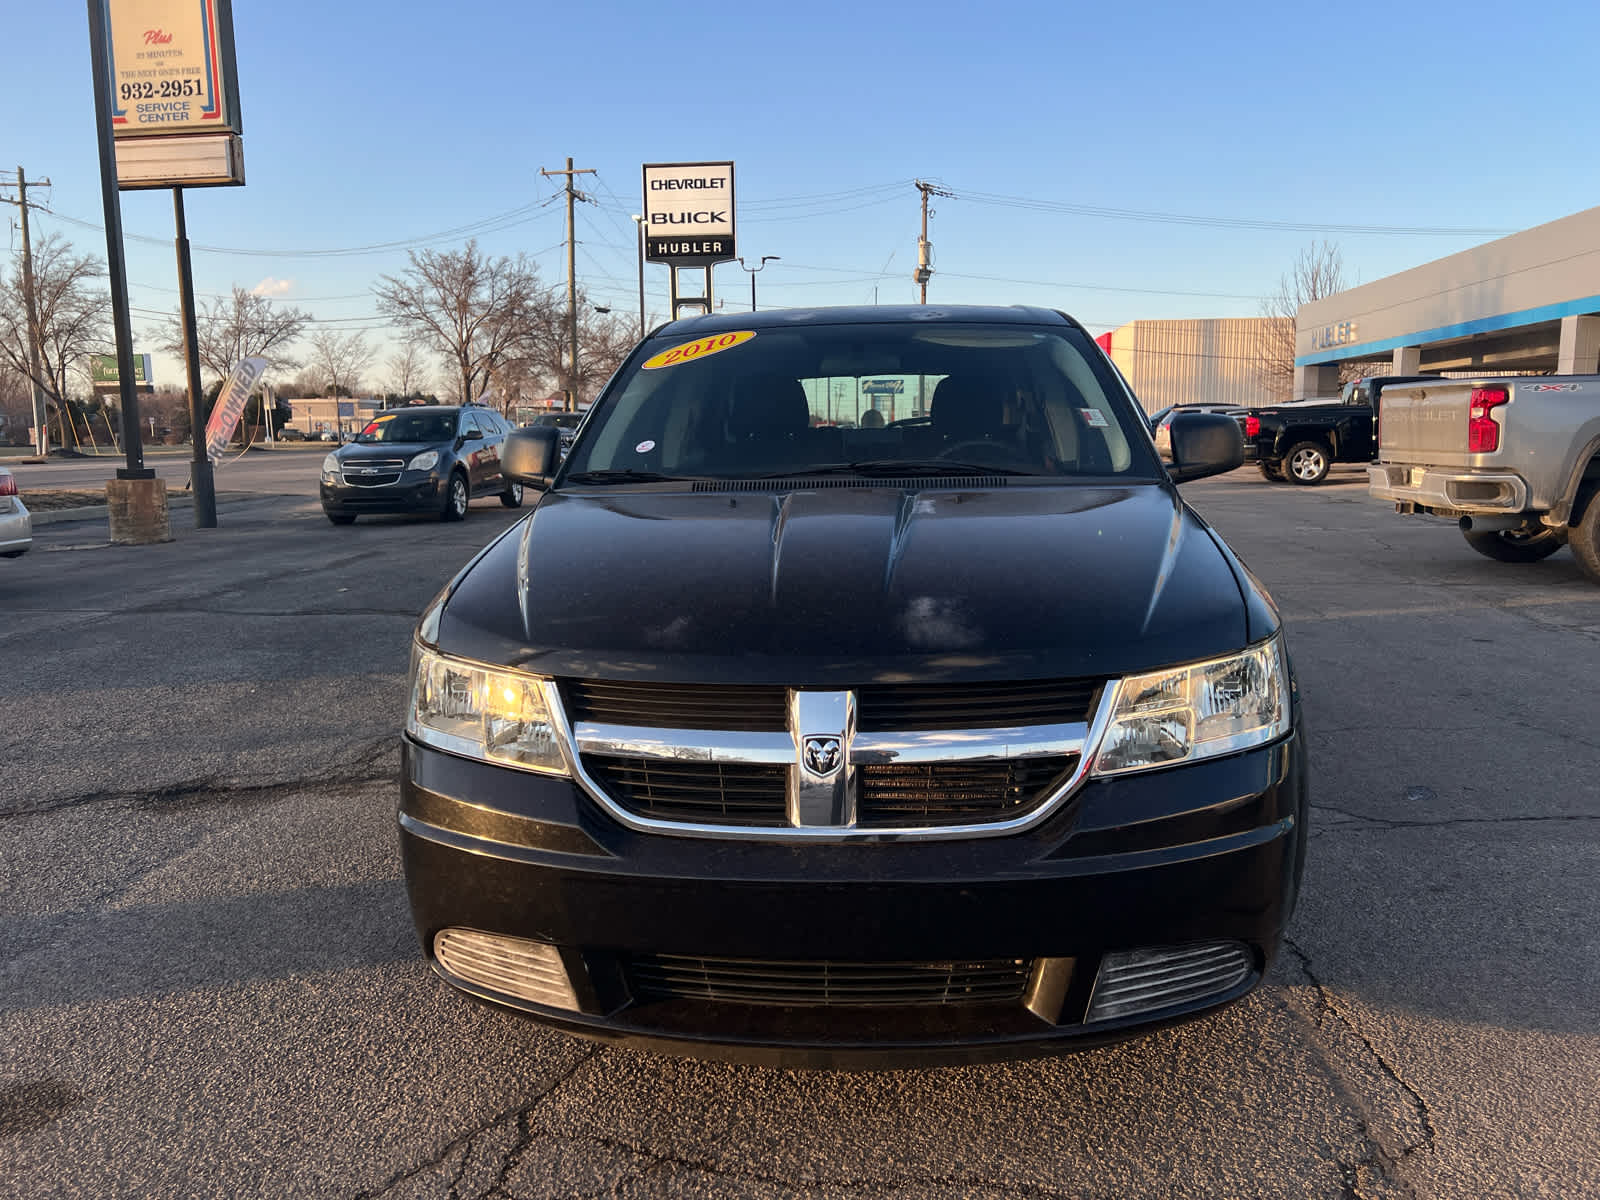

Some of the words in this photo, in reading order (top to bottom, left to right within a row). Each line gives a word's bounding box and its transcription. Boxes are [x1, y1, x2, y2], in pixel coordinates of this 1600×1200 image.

[143, 29, 173, 45] Plus
[181, 67, 201, 75] FREE
[120, 78, 204, 101] 932-2951
[136, 101, 191, 113] SERVICE
[138, 111, 189, 123] CENTER
[650, 178, 727, 190] CHEVROLET
[651, 211, 728, 224] BUICK
[658, 242, 722, 254] HUBLER
[663, 334, 737, 365] 2010
[206, 361, 256, 461] RE-OWNED
